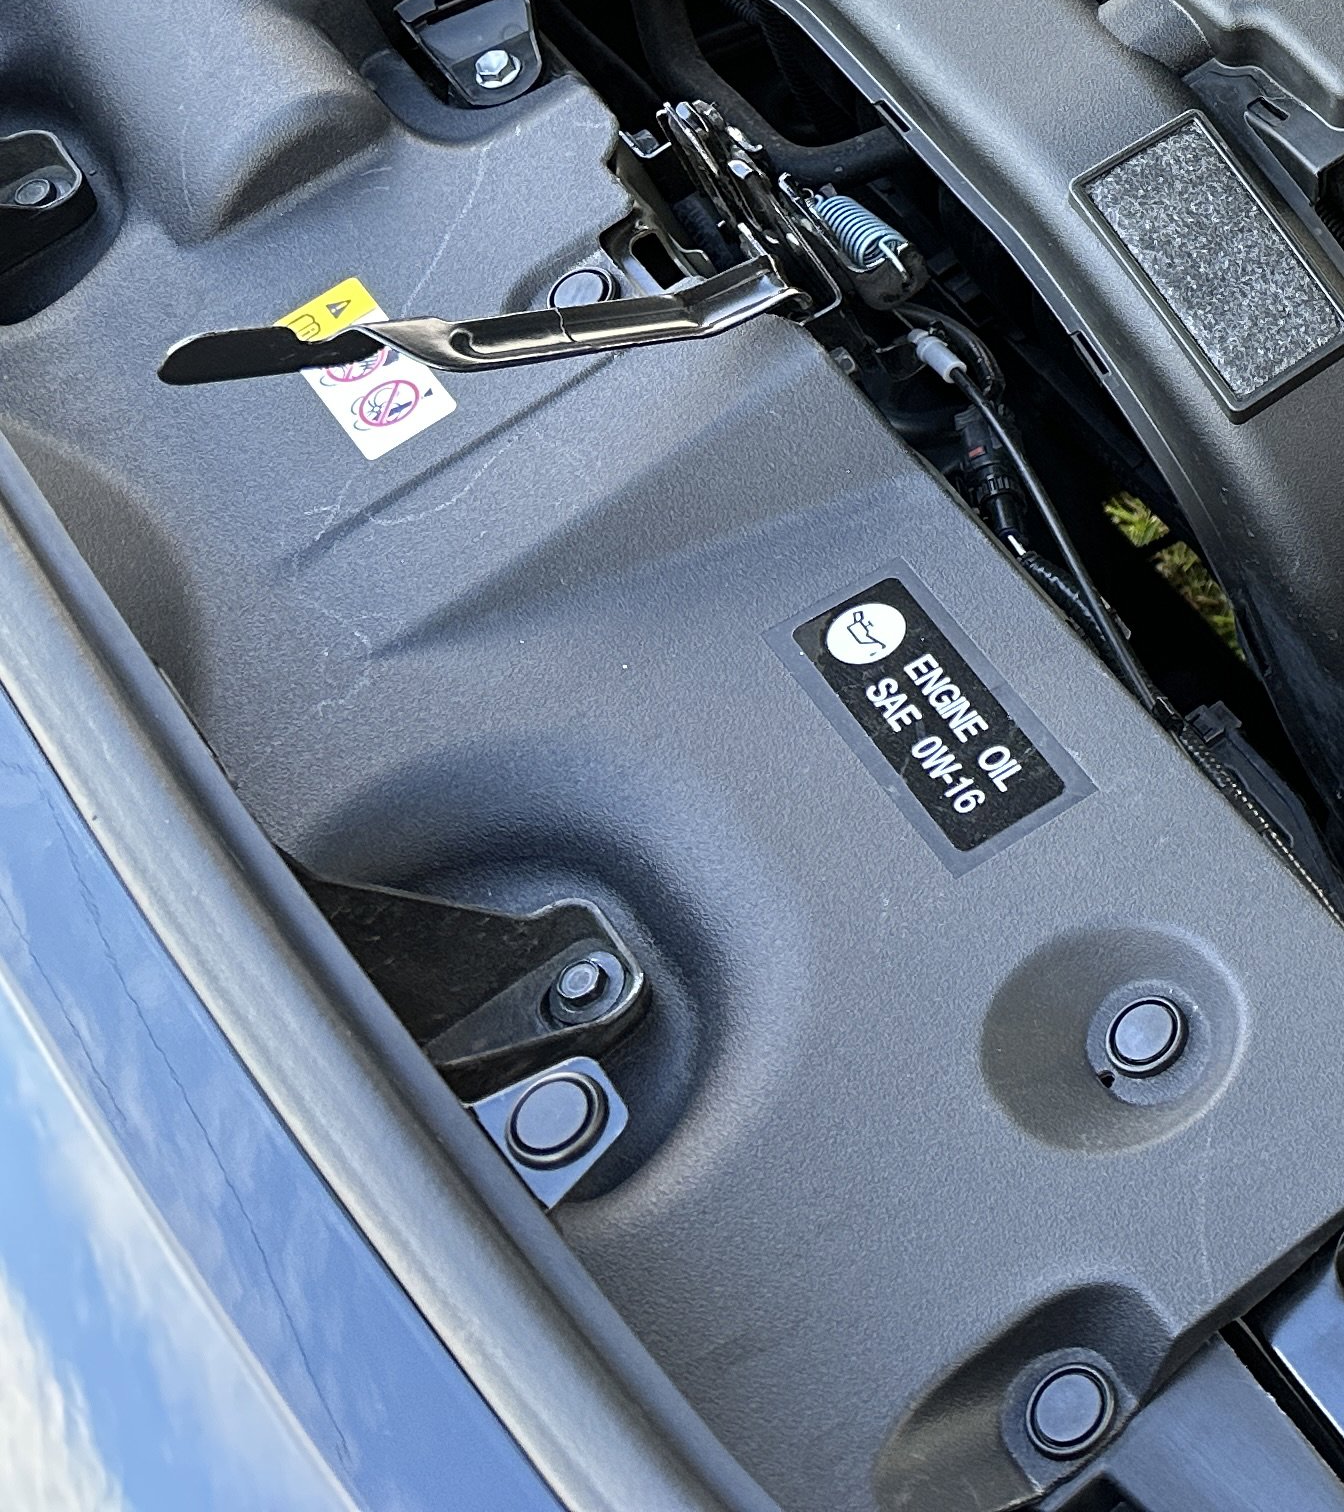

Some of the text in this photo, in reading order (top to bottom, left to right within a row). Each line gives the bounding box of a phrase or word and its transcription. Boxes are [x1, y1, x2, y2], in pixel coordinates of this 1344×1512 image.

[865, 676, 987, 815] SAE 0W-16
[903, 651, 1024, 794] ENGINE OIL
